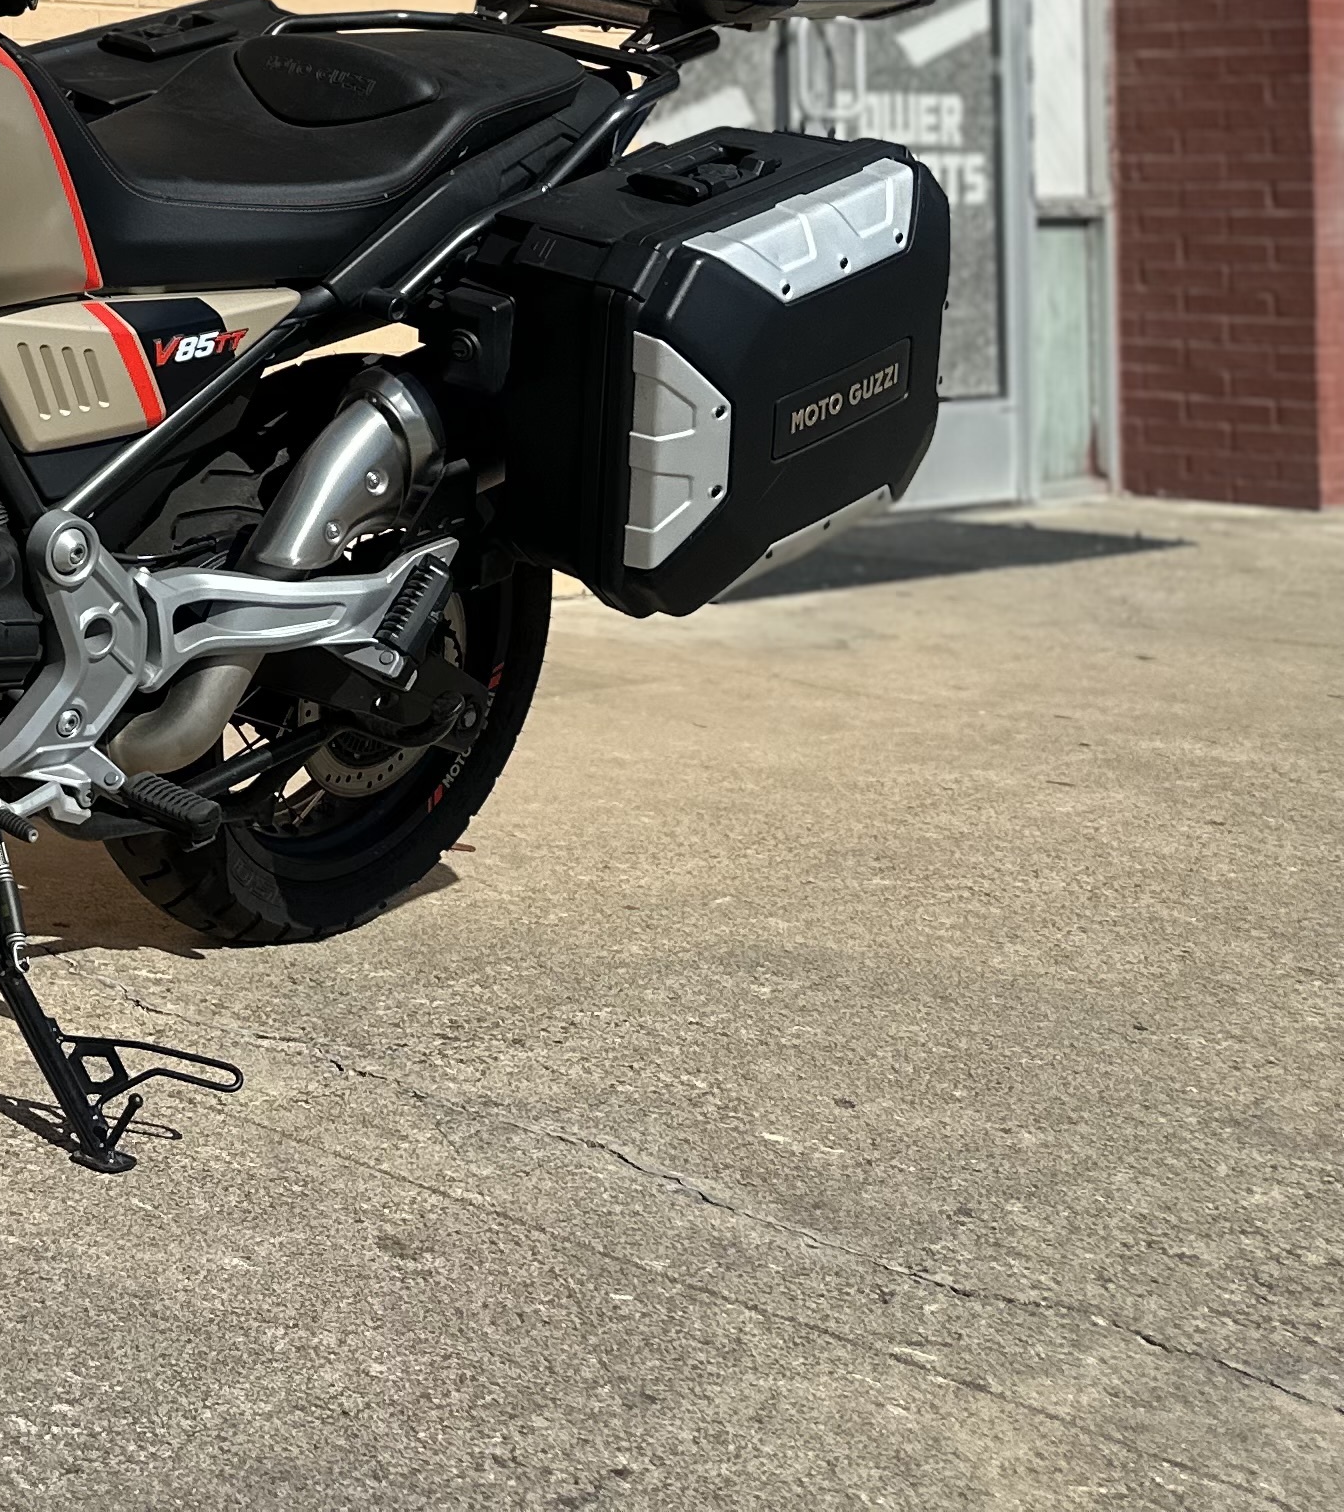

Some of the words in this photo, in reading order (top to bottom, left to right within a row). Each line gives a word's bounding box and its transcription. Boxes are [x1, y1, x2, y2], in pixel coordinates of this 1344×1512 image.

[153, 328, 250, 367] V85TT
[790, 392, 844, 435] MOTO
[848, 362, 900, 406] GUZZI
